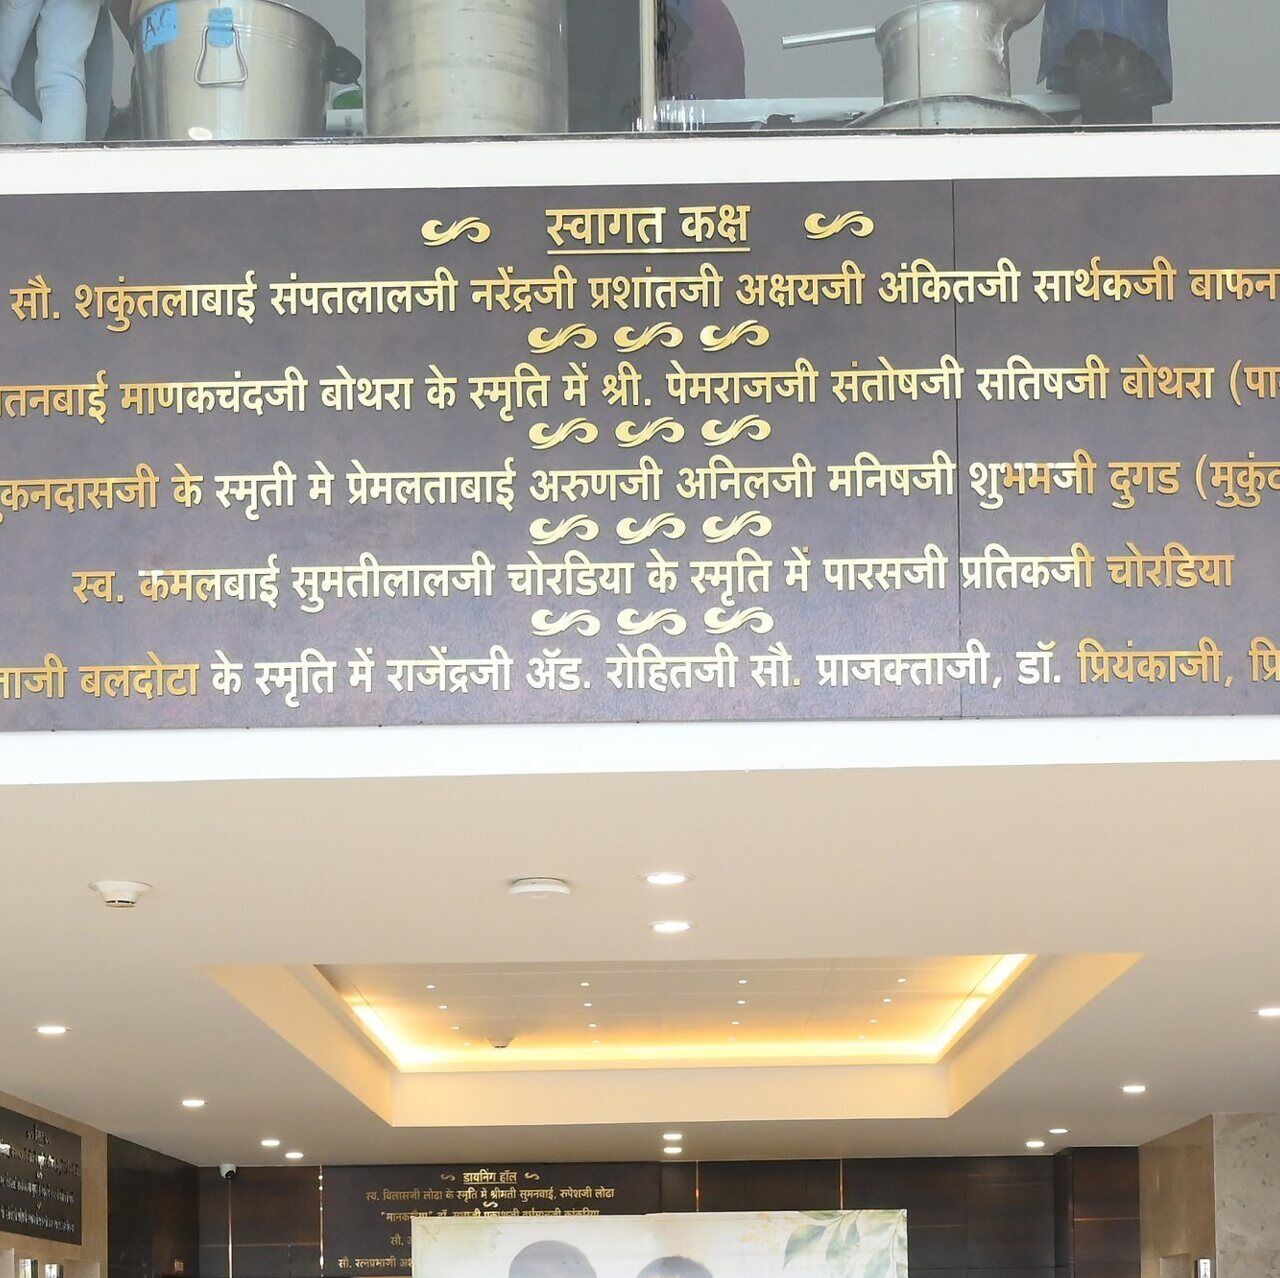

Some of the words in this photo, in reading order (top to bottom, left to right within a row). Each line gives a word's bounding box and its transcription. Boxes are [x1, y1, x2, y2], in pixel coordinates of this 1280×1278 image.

[545, 207, 667, 246] स्वागत
[678, 204, 751, 243] कक्ष
[9, 274, 60, 320] सौ.
[74, 270, 258, 332] शकुंतलाबाई
[269, 266, 459, 316] संपतलालजी
[470, 264, 578, 313] नरेंद्रजी
[587, 262, 724, 310] प्रशांतजी
[736, 259, 866, 308] अक्षयजी
[878, 257, 1022, 304] अंकितजी
[1032, 255, 1178, 302] सार्थकजी
[119, 366, 309, 416] माणकचंदजी
[319, 365, 414, 411] बोथरा
[424, 364, 458, 409] के
[468, 361, 552, 424] स्मृति
[561, 362, 589, 406] में
[602, 361, 652, 406] श्री.
[830, 353, 965, 403] संतोषजी
[975, 353, 1111, 401] सतिषजी
[1120, 353, 1216, 399] बोथरा
[171, 463, 204, 507] के
[345, 457, 517, 512] प्रेमलताबाई
[529, 455, 664, 502] अरुणजी
[676, 452, 816, 500] अनिलजी
[827, 449, 957, 497] मनिषजी
[969, 447, 1098, 510] शुभमजी
[1107, 460, 1182, 509] दुगड
[72, 570, 124, 604] स्व.
[137, 553, 280, 609] कमलबाई
[291, 550, 496, 613] सुमतीलालजी
[506, 549, 635, 596] चोरडिया
[645, 548, 679, 594] के
[689, 547, 773, 608] स्मृति
[783, 546, 811, 592] में
[822, 543, 949, 591] पारसजी
[959, 542, 1097, 590] प्रतिकजी
[1105, 540, 1237, 588] चोरडिया
[78, 651, 201, 700] बलदोटा
[210, 649, 244, 696] के
[253, 647, 338, 708] स्मृति
[347, 647, 375, 693] में
[385, 644, 514, 693] राजेंद्रजी
[605, 641, 739, 692] रोहितजी
[749, 640, 800, 688] सौ.
[815, 638, 1002, 689] प्राजक्ताजी,
[1015, 640, 1061, 685] डॉ.
[1076, 636, 1233, 688] प्रियंकाजी,
[500, 1168, 517, 1182] हॉल
